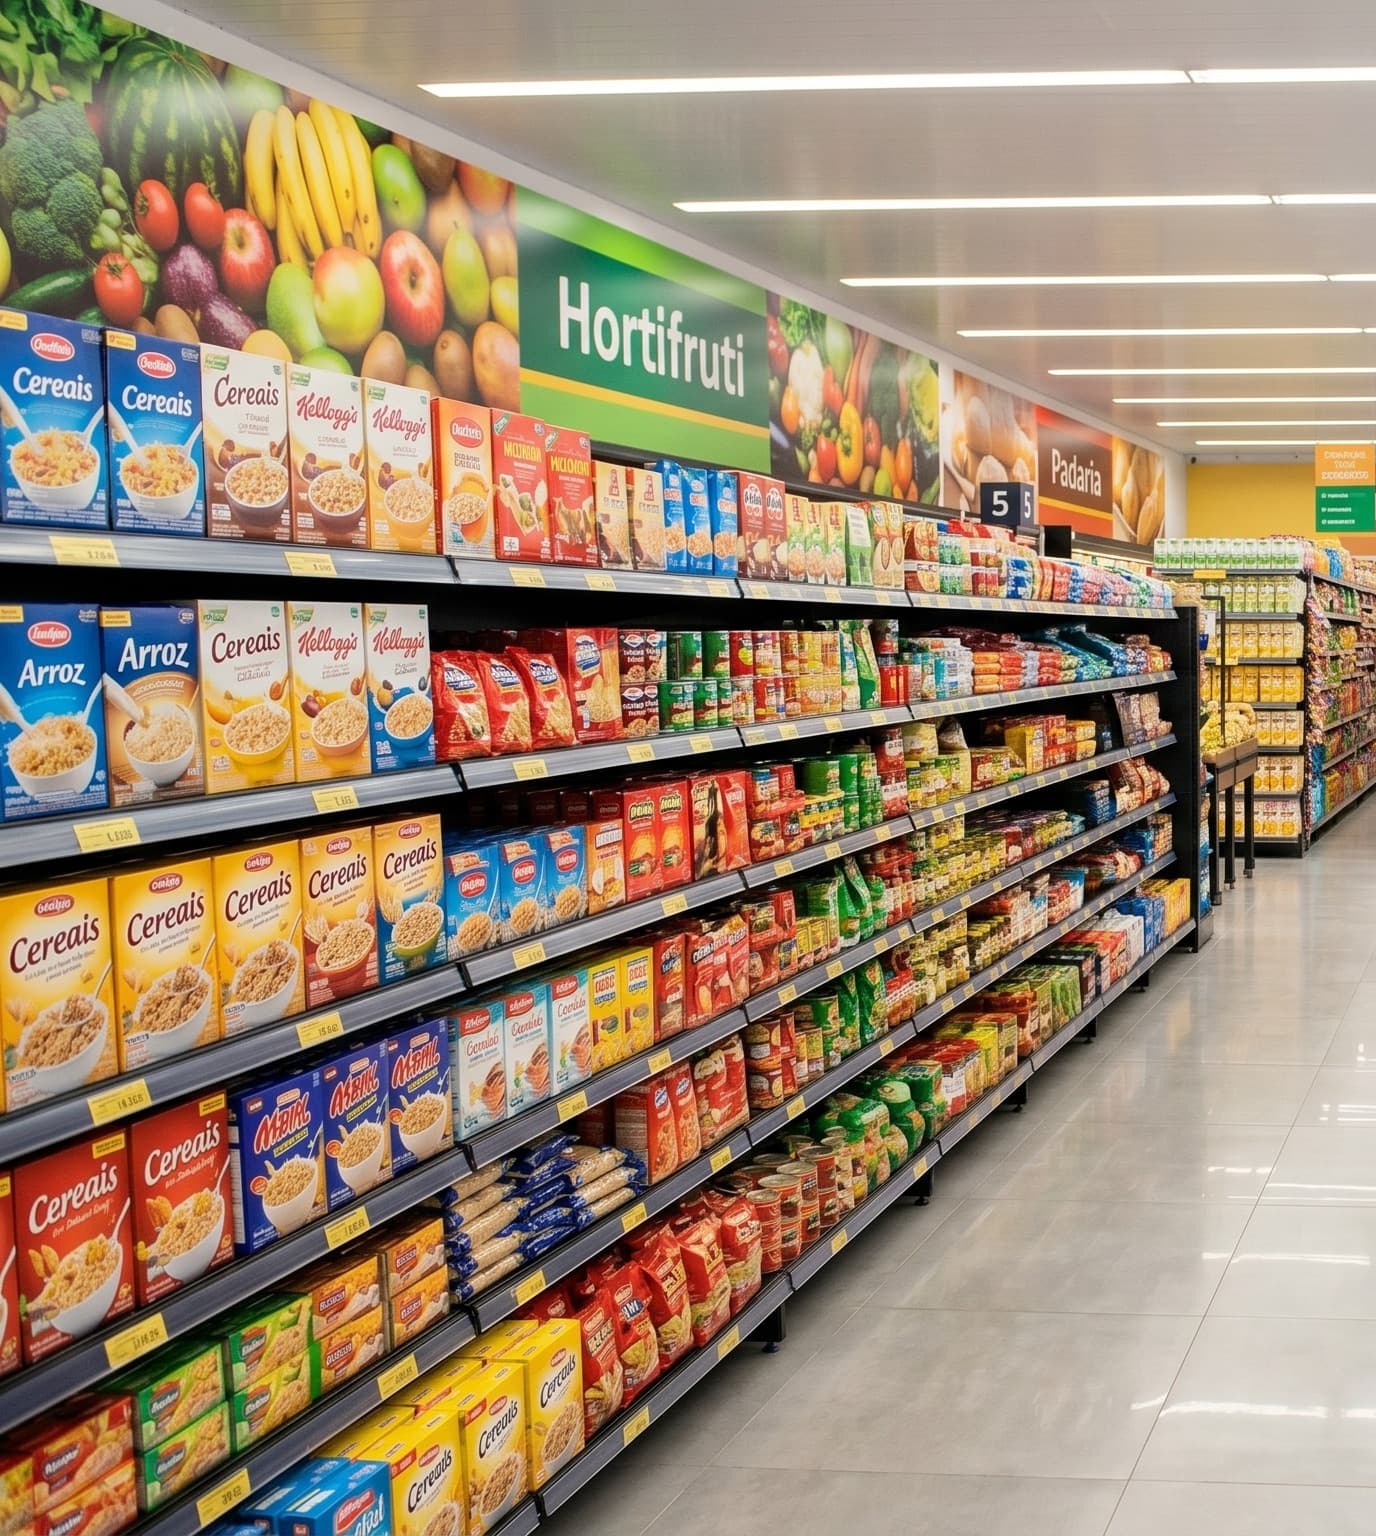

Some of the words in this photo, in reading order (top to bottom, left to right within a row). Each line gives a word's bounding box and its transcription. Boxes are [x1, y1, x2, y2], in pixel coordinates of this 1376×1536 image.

[559, 275, 745, 397] Hortifruti
[13, 366, 93, 402] Cereais
[122, 384, 192, 417] Cereais
[214, 374, 279, 407] Cereais
[1051, 448, 1102, 497] Padaria
[991, 490, 1009, 517] 5
[1024, 491, 1031, 519] 5
[117, 637, 191, 673] Arroz
[211, 626, 281, 664] Cereais
[17, 658, 87, 689] Arroz
[308, 853, 367, 899] Cereais
[383, 837, 437, 880] Cereais
[225, 870, 292, 922] Cereais
[127, 891, 205, 947] Cereais
[9, 913, 100, 974] Cereais
[144, 1119, 221, 1187] Cereais
[28, 1161, 118, 1235] Cereais
